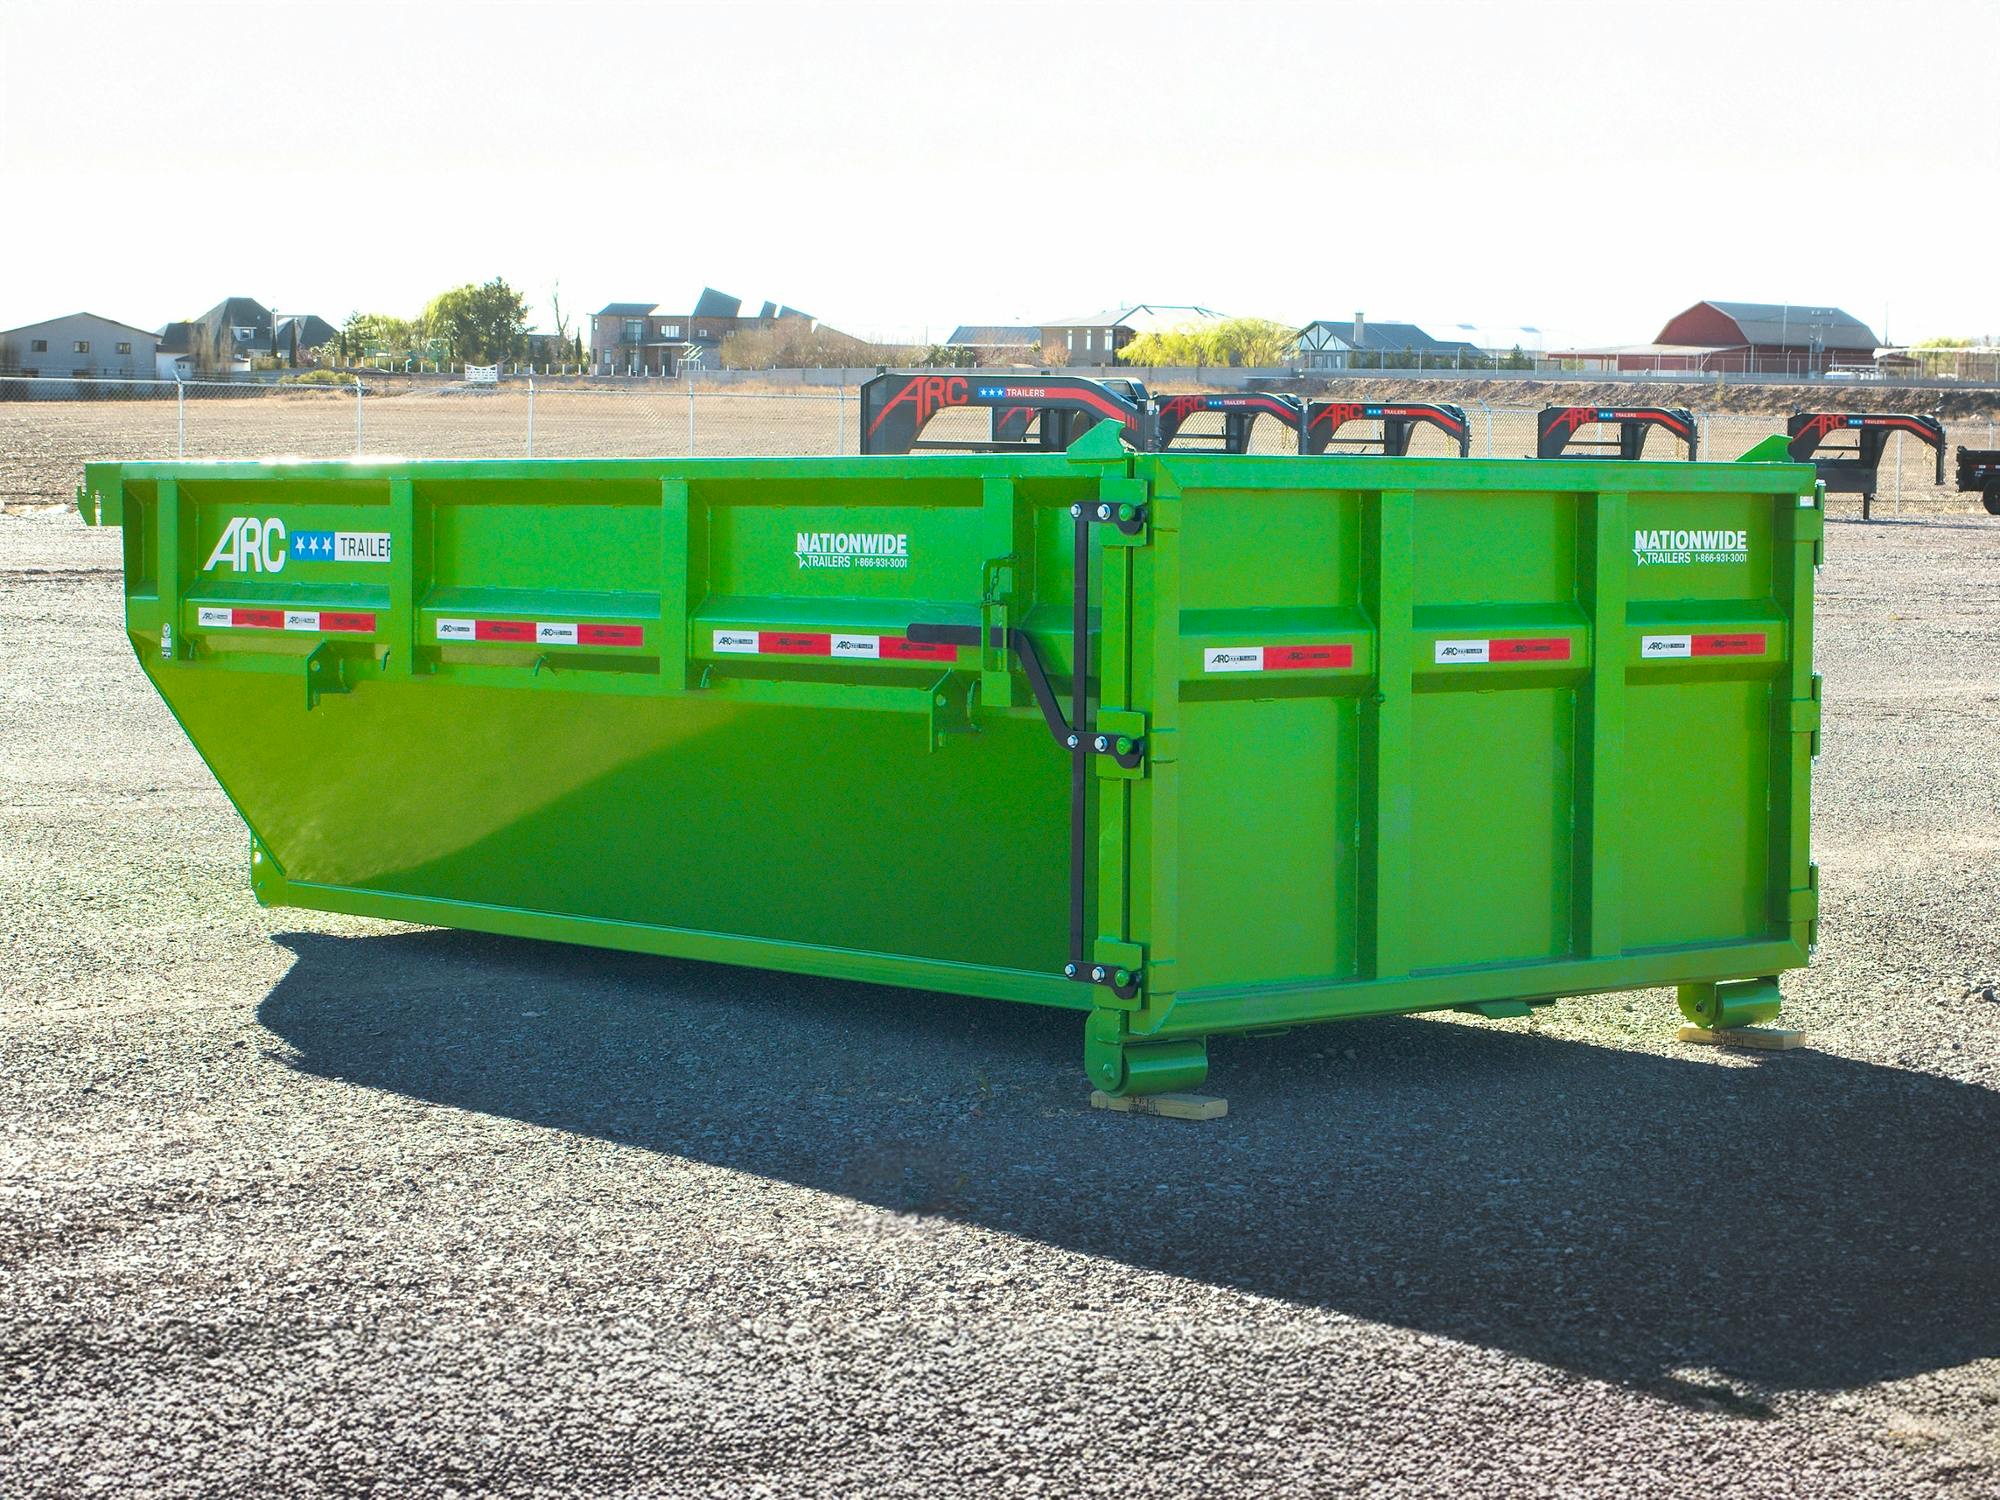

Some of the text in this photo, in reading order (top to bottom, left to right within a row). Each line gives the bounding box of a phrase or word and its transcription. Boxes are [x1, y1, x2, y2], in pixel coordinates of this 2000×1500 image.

[868, 376, 969, 438] ARC
[1006, 388, 1045, 397] TRAILERS
[1159, 396, 1206, 421] ARC
[1308, 403, 1363, 431] ARC
[1544, 408, 1598, 437] ARC
[1789, 415, 1847, 444] ARC
[203, 517, 286, 572] ARC
[797, 532, 907, 554] NATIONWIDE
[1635, 530, 1747, 550] NATIONWIDE
[808, 555, 907, 568] TRAILERS 1-866-931-3001
[1646, 552, 1747, 564] TRAILERS 1-866-931-3001
[718, 636, 733, 646] ARC
[836, 640, 851, 650] ARC
[1648, 642, 1663, 651] ARC
[1212, 654, 1229, 664] ARC
[1441, 647, 1458, 656] ARC
